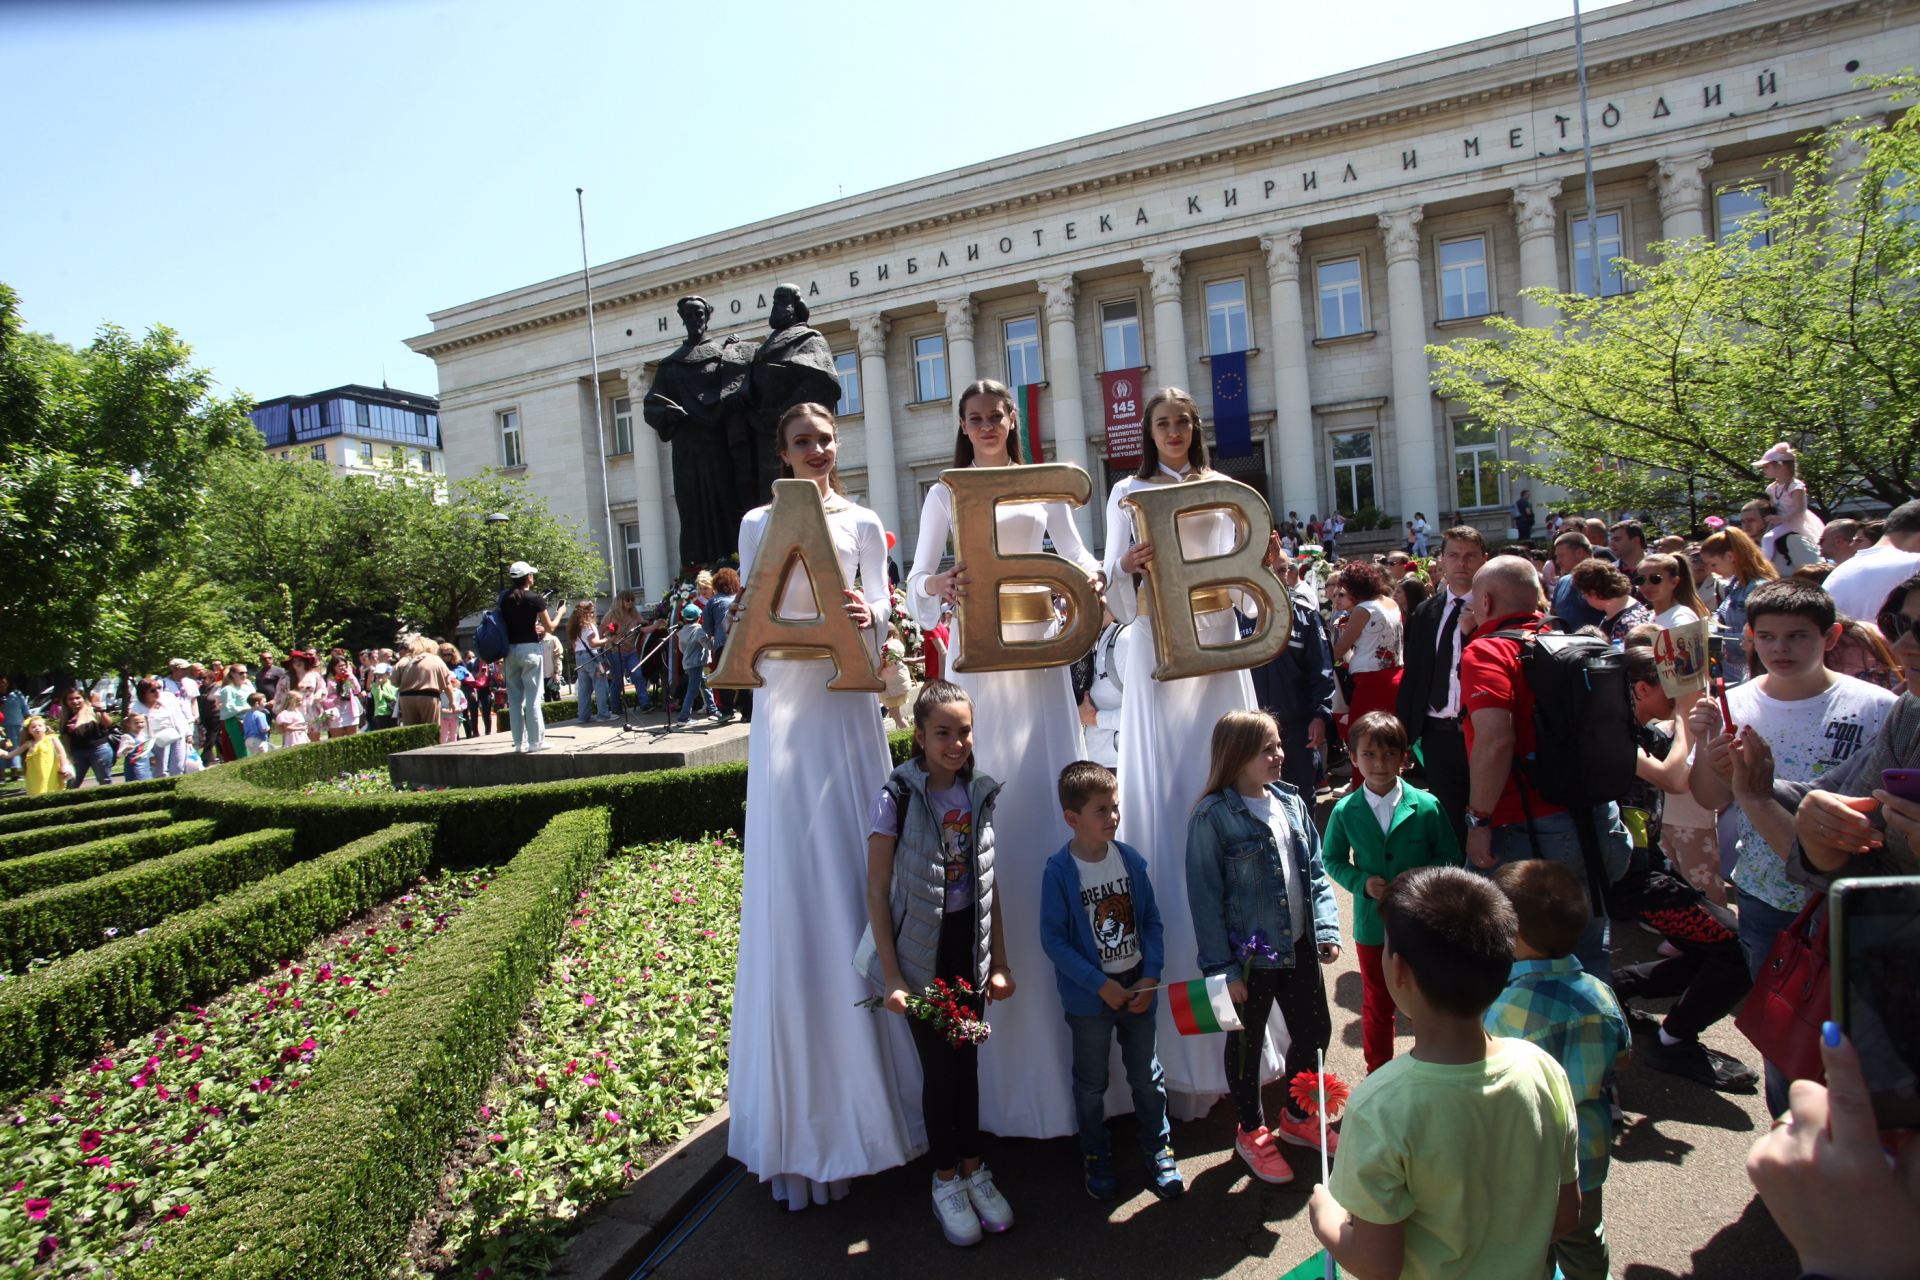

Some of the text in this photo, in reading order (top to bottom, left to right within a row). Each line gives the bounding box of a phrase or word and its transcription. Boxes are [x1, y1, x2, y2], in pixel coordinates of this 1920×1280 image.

[849, 206, 1149, 288] БИБЛИОТЕКА
[1187, 163, 1358, 215] КИРИЛ
[1402, 150, 1418, 171] И
[1464, 68, 1777, 158] МЕТОДИЙ
[1112, 400, 1135, 414] 145
[1108, 430, 1142, 438] БИБЛИОТЕКА
[1824, 721, 1864, 743] COOL
[1081, 881, 1114, 907] BREAK
